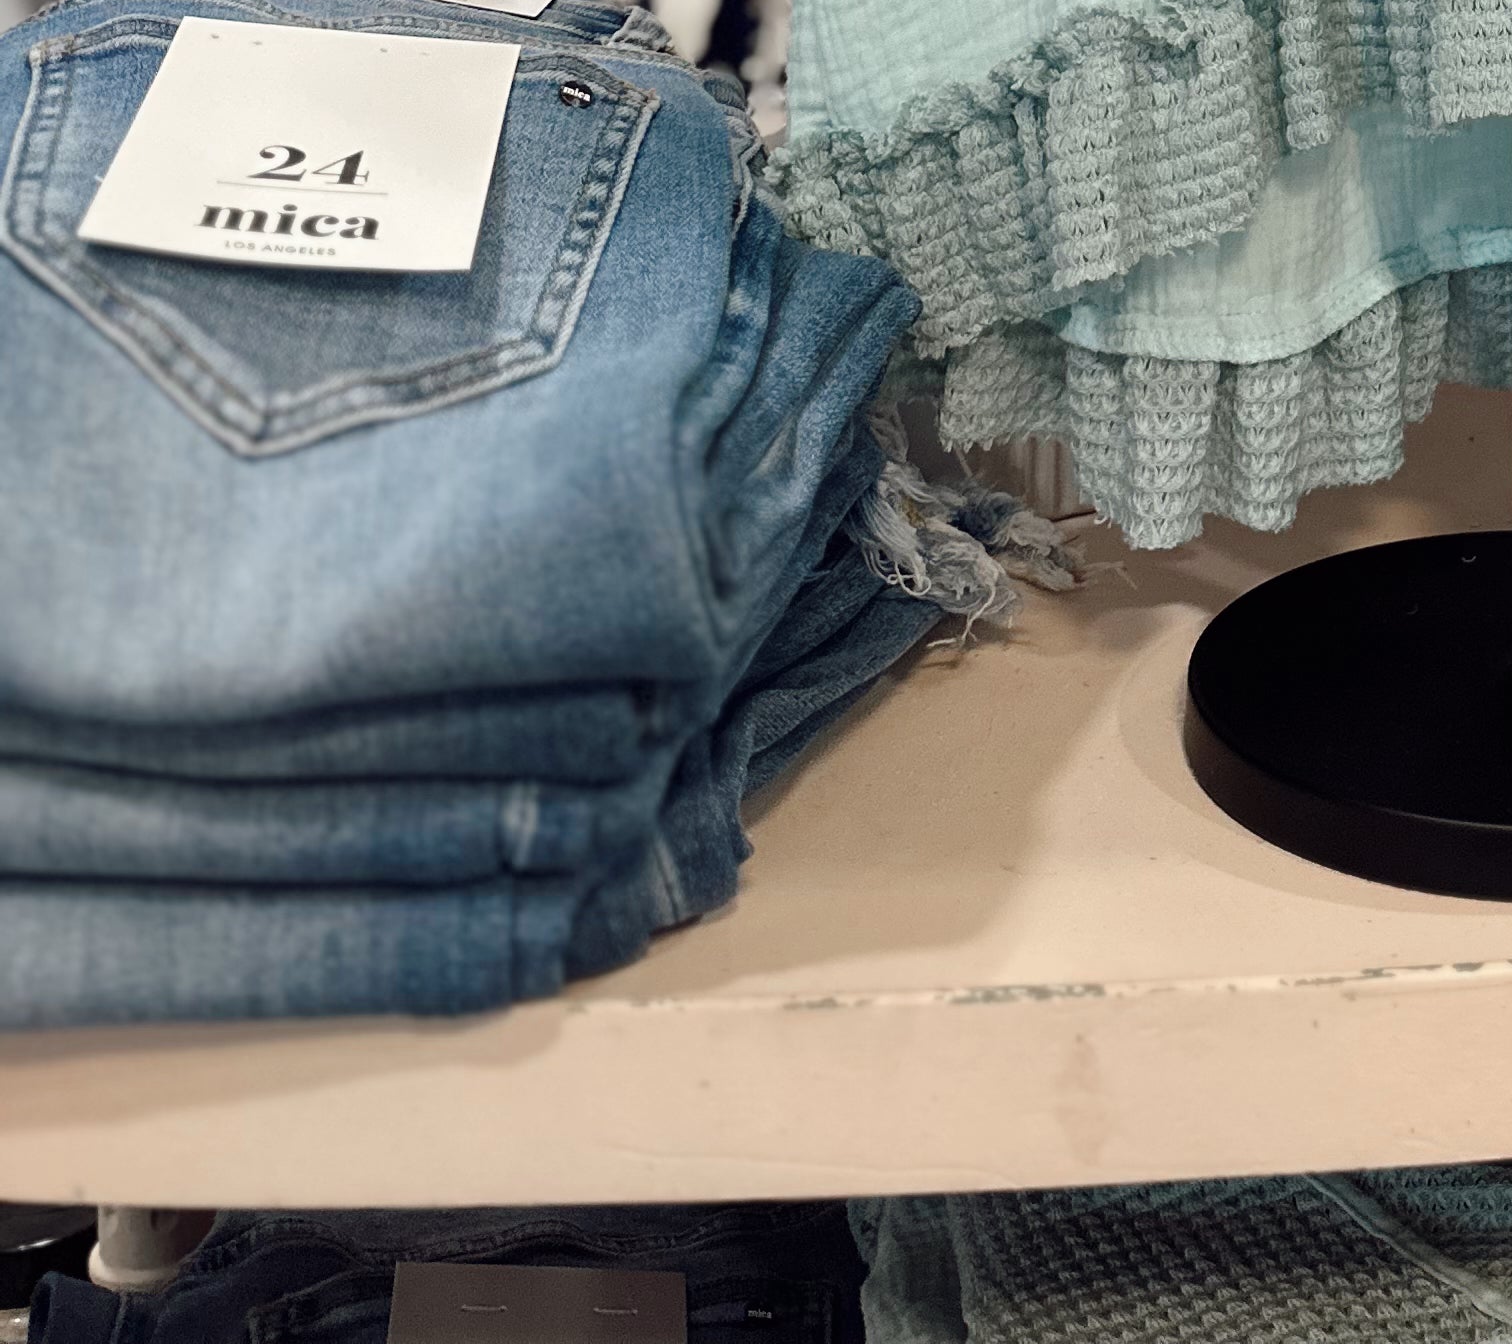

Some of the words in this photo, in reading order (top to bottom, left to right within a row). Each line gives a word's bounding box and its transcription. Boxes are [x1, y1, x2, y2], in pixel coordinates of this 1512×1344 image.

[561, 85, 591, 102] mica
[246, 144, 370, 186] 24
[194, 203, 379, 240] mica
[224, 240, 256, 250] LOS
[260, 244, 337, 257] ANGELES
